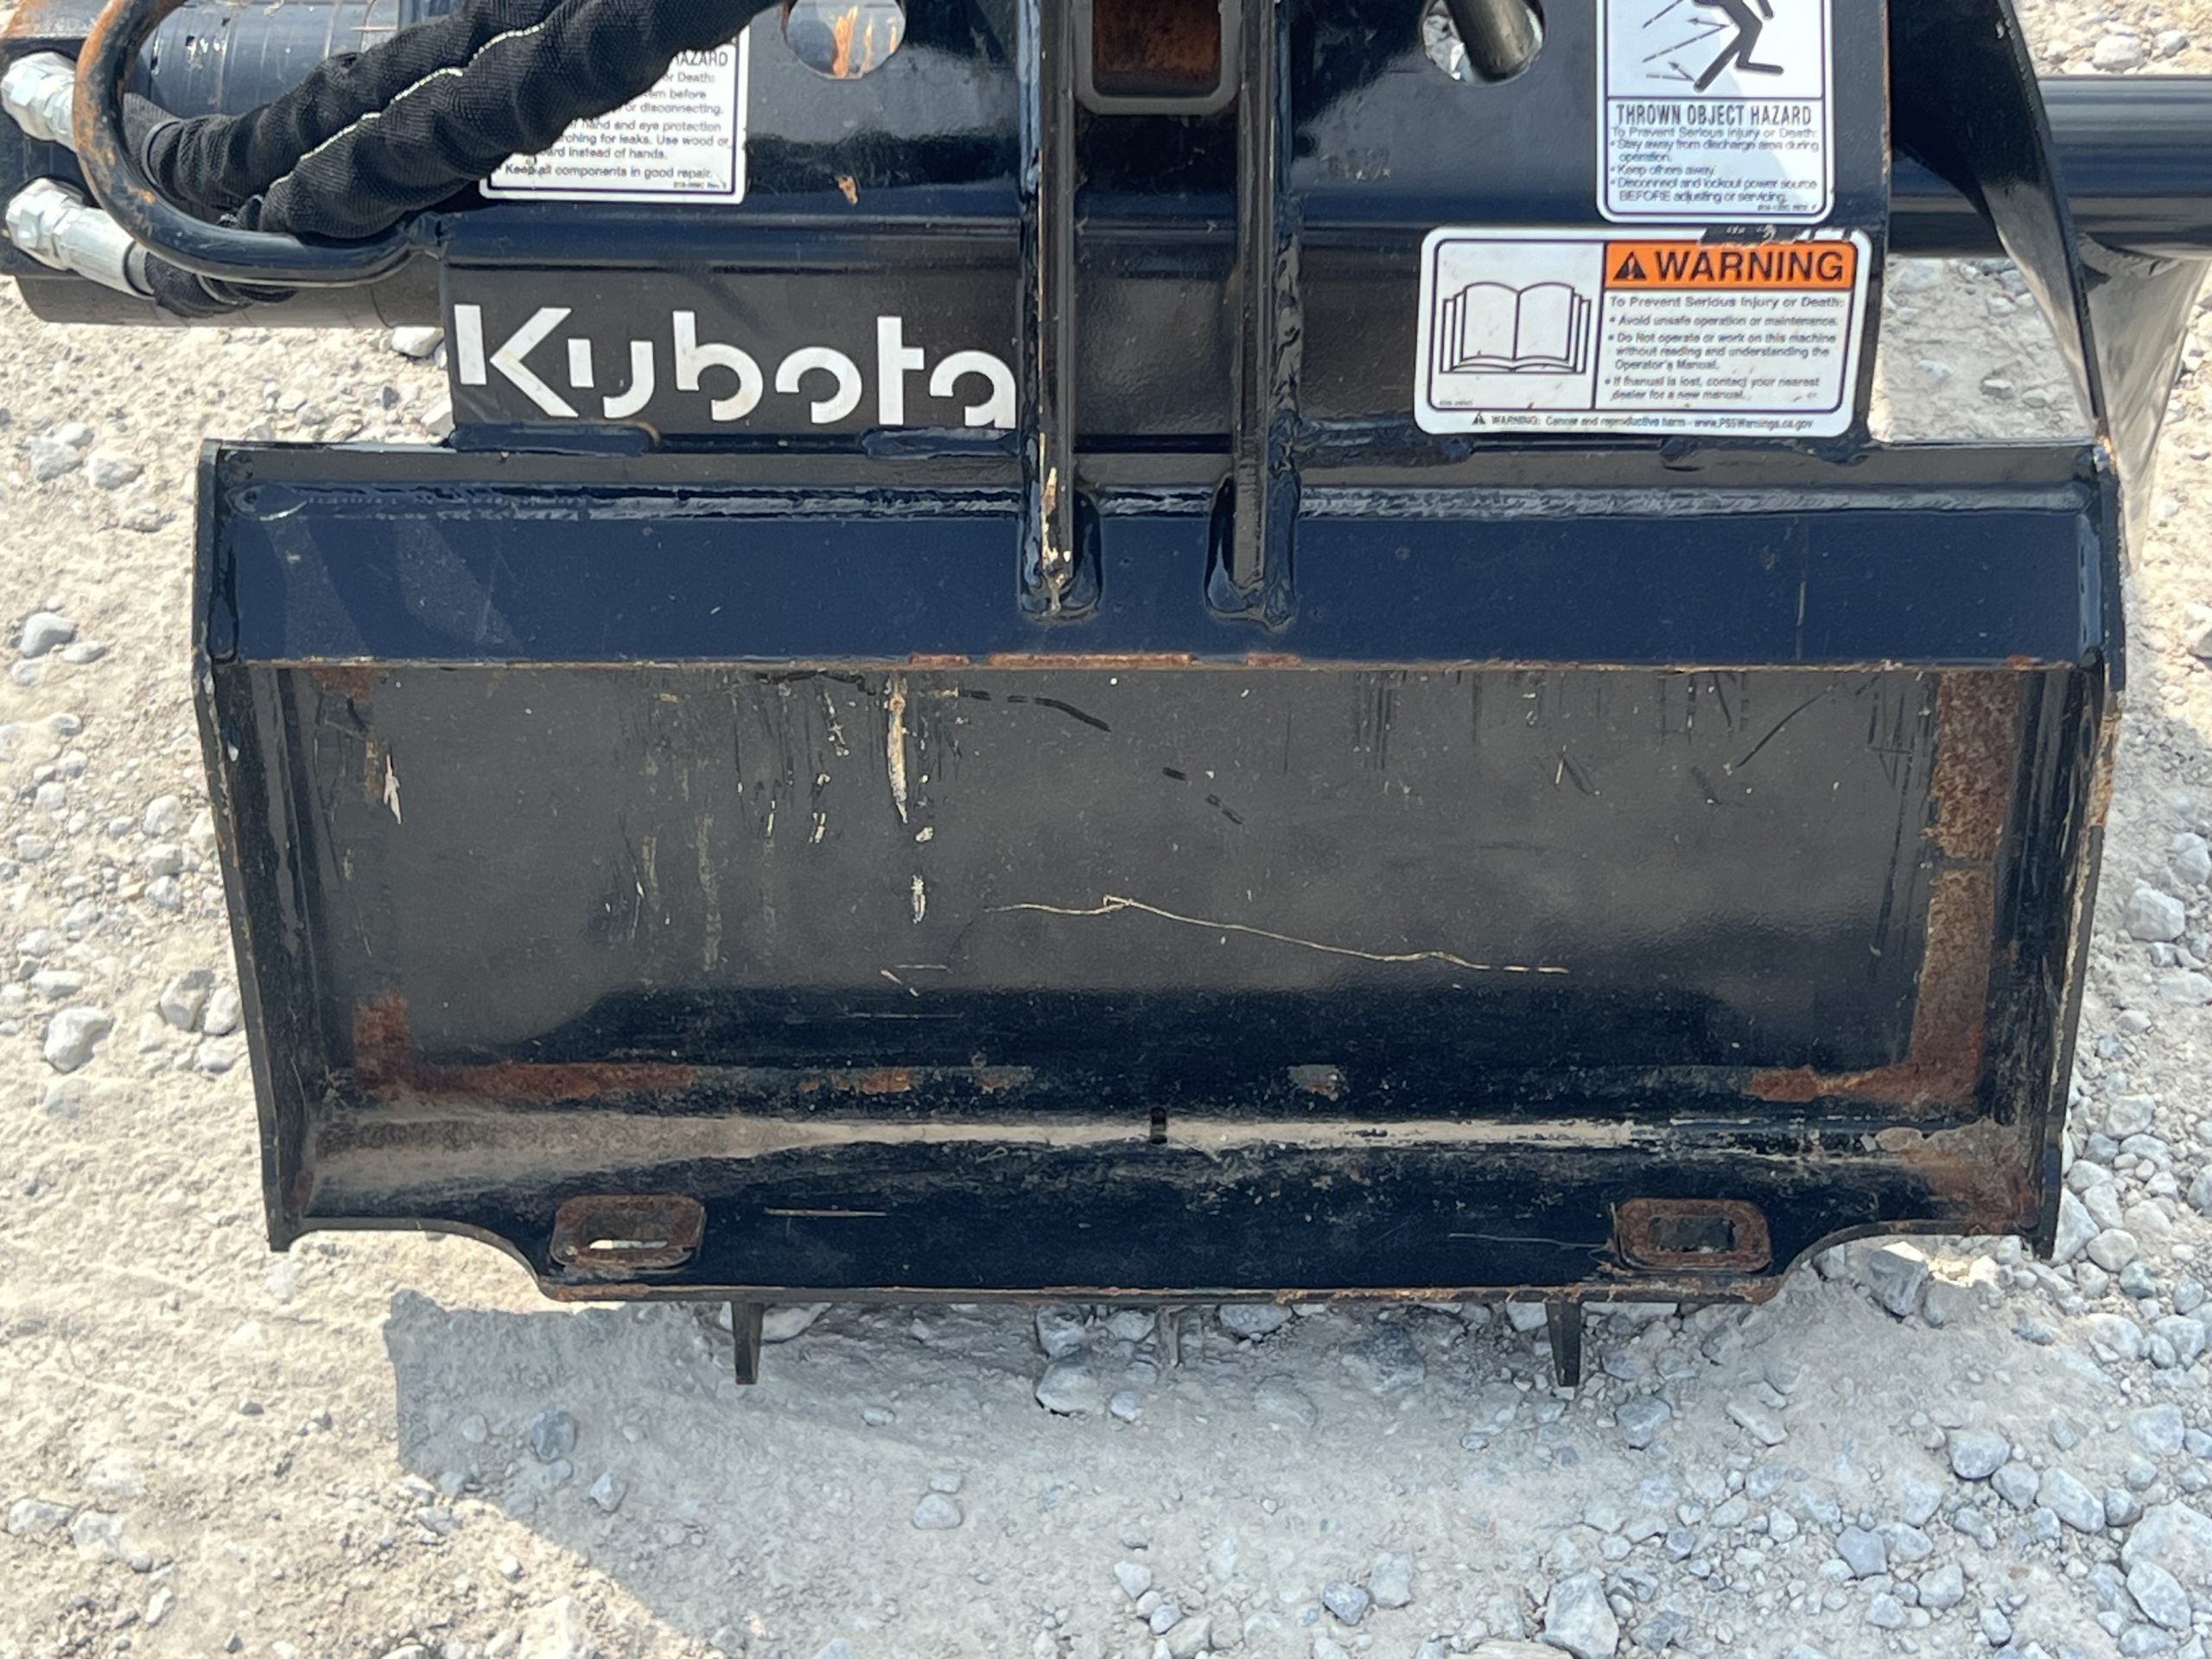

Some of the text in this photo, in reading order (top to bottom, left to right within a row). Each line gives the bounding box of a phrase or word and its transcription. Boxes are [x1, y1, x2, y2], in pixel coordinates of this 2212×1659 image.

[670, 88, 707, 99] before
[640, 103, 723, 116] disconnecting.
[1616, 104, 1812, 126] THROWN OBJECT HAZARD
[614, 120, 636, 130] and
[639, 122, 658, 132] eye
[663, 121, 721, 132] protection
[600, 133, 615, 143] for
[620, 134, 652, 144] leaks.
[657, 134, 678, 145] Use
[683, 136, 714, 146] wood
[717, 137, 728, 145] or
[1611, 126, 1625, 138] To
[1629, 126, 1675, 138] Prevent
[1679, 126, 1724, 138] Serious
[1728, 127, 1760, 140] Injury
[1764, 129, 1776, 138] or
[614, 148, 626, 158] of
[628, 148, 667, 159] hands.
[505, 162, 535, 176] Keep
[538, 164, 551, 175] all
[555, 164, 627, 178] components
[631, 166, 640, 177] in
[644, 168, 673, 180] good
[1618, 165, 1647, 178] Keep
[1649, 165, 1683, 175] others
[1619, 190, 1671, 202] BEFORE
[1674, 191, 1722, 204] adjusting
[1724, 193, 1735, 202] or
[1654, 250, 1844, 282] WARNING
[1610, 296, 1845, 310] To Prevent Serious Injury or Death:
[1618, 315, 1650, 326] Avoid
[1653, 315, 1691, 327] unsafe
[1694, 316, 1746, 327] operation
[1749, 317, 1762, 326] or
[1617, 333, 1836, 345] Do Not operate or work on this machine
[1616, 346, 1829, 359] without reading and understanding the
[454, 304, 1016, 429] Kubota
